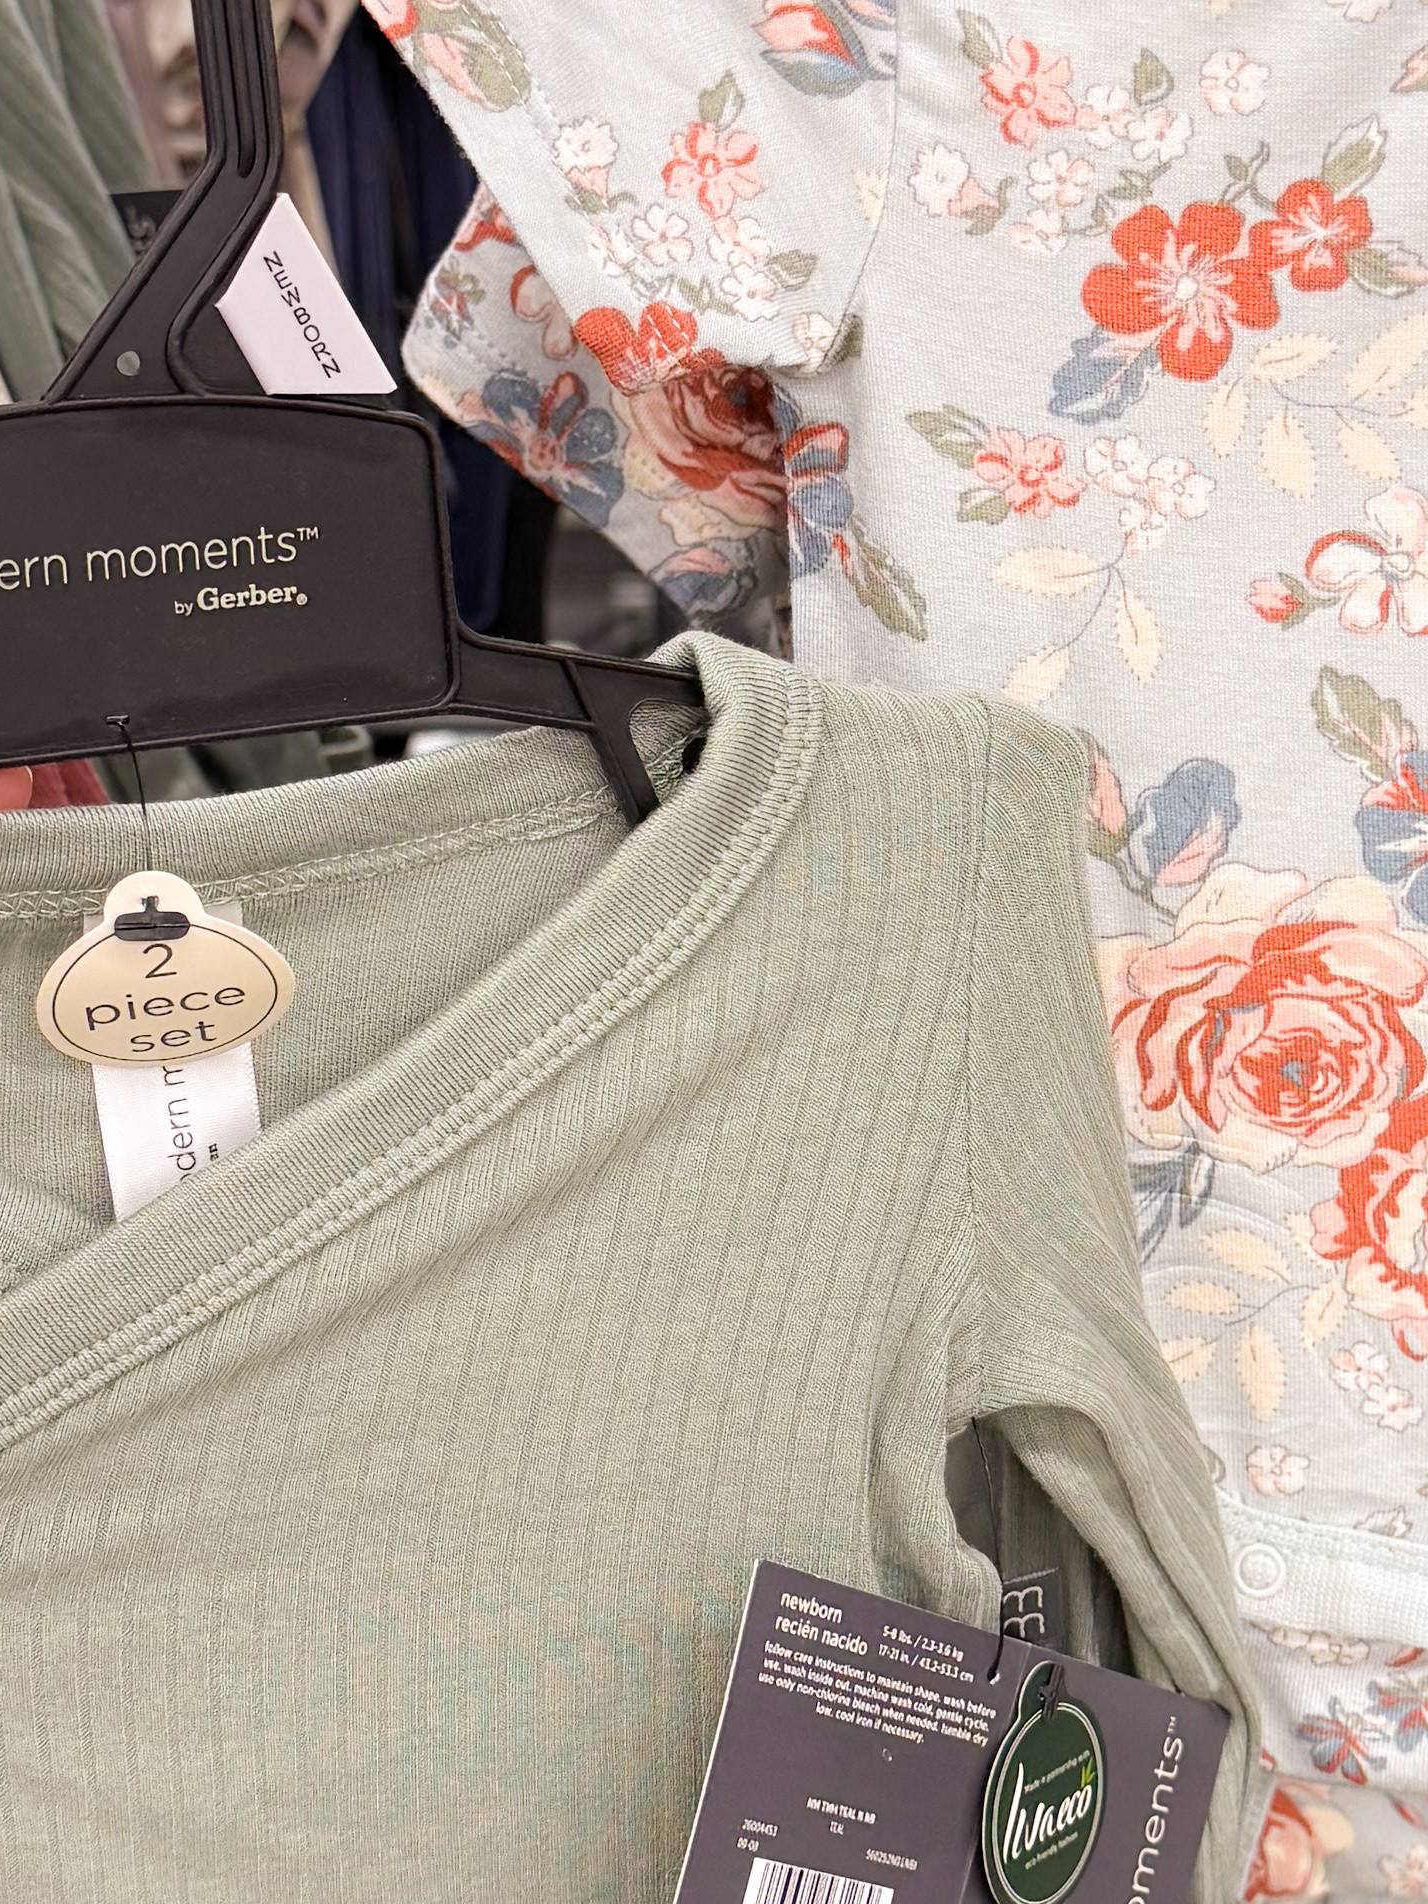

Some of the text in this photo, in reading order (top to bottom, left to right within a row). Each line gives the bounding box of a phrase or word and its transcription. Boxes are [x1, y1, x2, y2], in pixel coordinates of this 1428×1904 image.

[263, 250, 342, 379] NEWBORN
[174, 597, 194, 616] by
[143, 944, 177, 980] 2
[85, 986, 247, 1032] piece
[130, 1021, 217, 1053] set
[166, 1096, 198, 1182] dern
[779, 1587, 845, 1624] newborn
[773, 1610, 871, 1656] recién nacido
[757, 1671, 775, 1685] use
[773, 1674, 796, 1693] only
[792, 1650, 814, 1665] care
[813, 1654, 866, 1680] instructions
[865, 1670, 877, 1684] to
[958, 1670, 975, 1683] cm
[834, 1706, 856, 1723] cool
